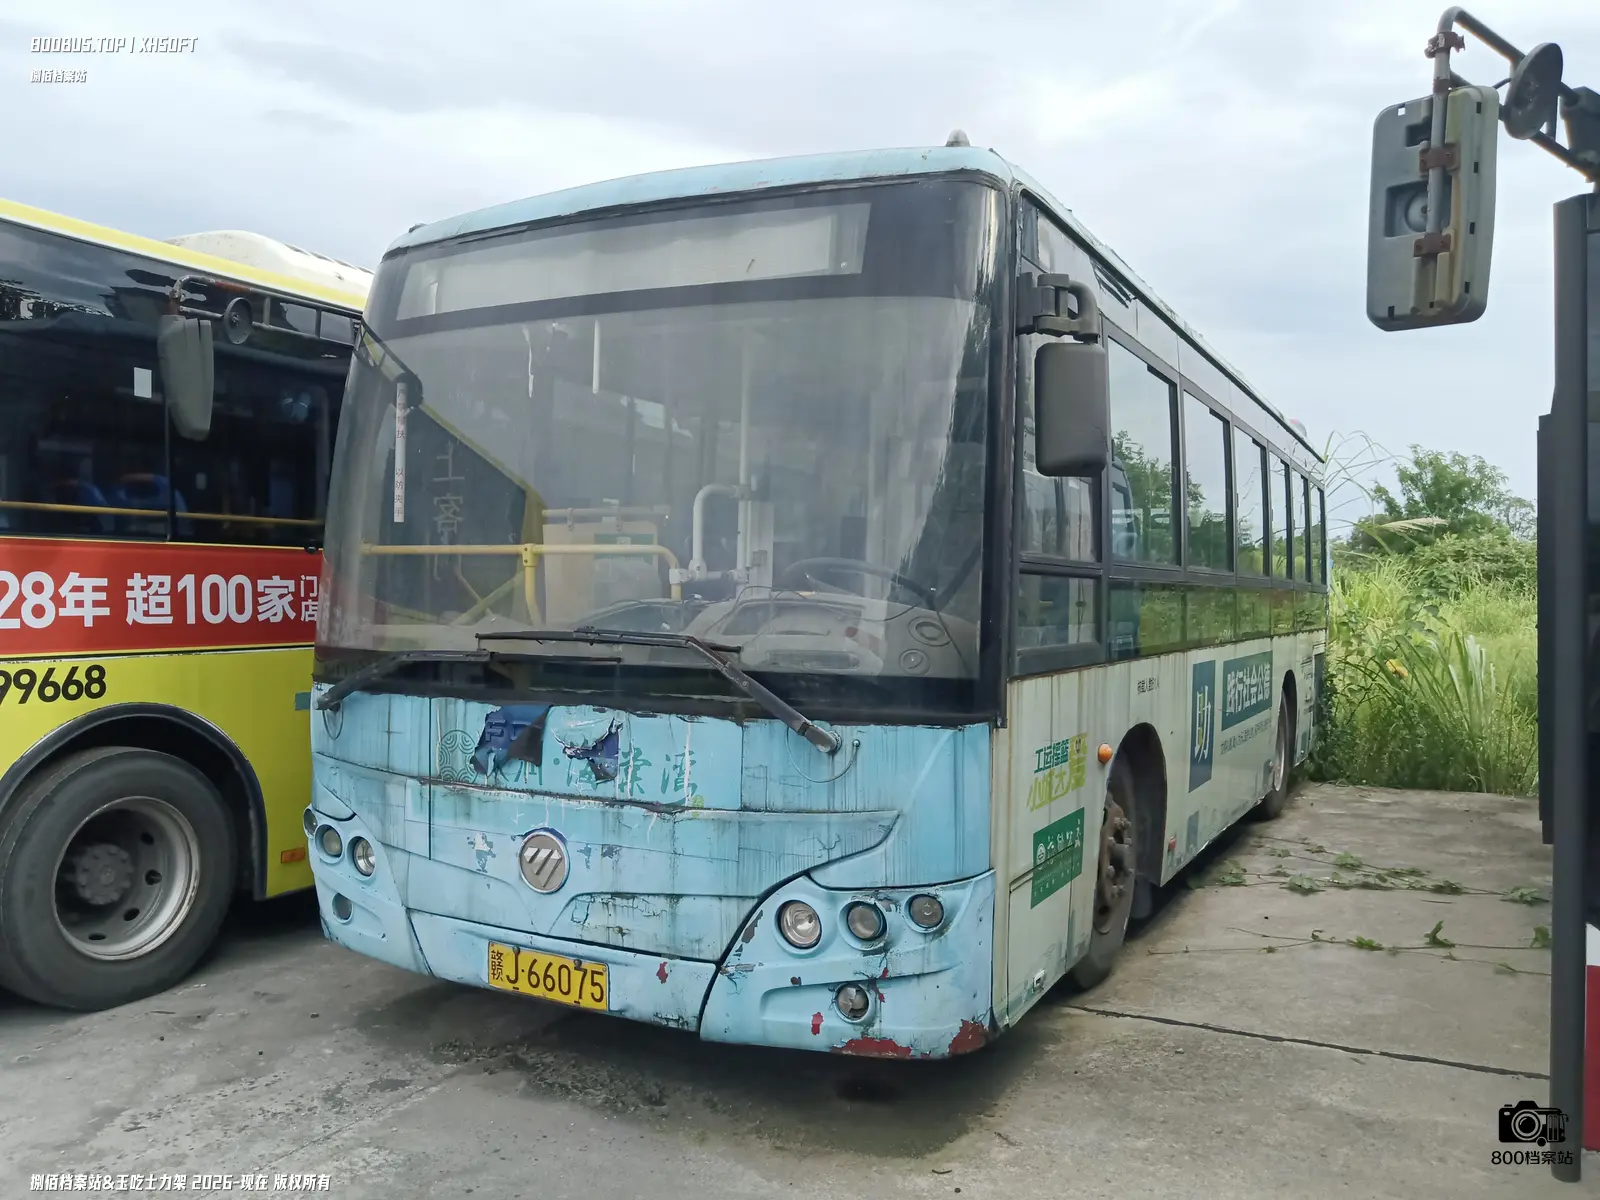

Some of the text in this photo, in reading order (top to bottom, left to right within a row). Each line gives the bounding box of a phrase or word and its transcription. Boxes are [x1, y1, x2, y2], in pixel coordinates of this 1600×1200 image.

[0, 571, 110, 629] 28年
[126, 573, 296, 625] 超100家
[1226, 662, 1271, 716] 践行社会公德
[1194, 684, 1212, 763] 助
